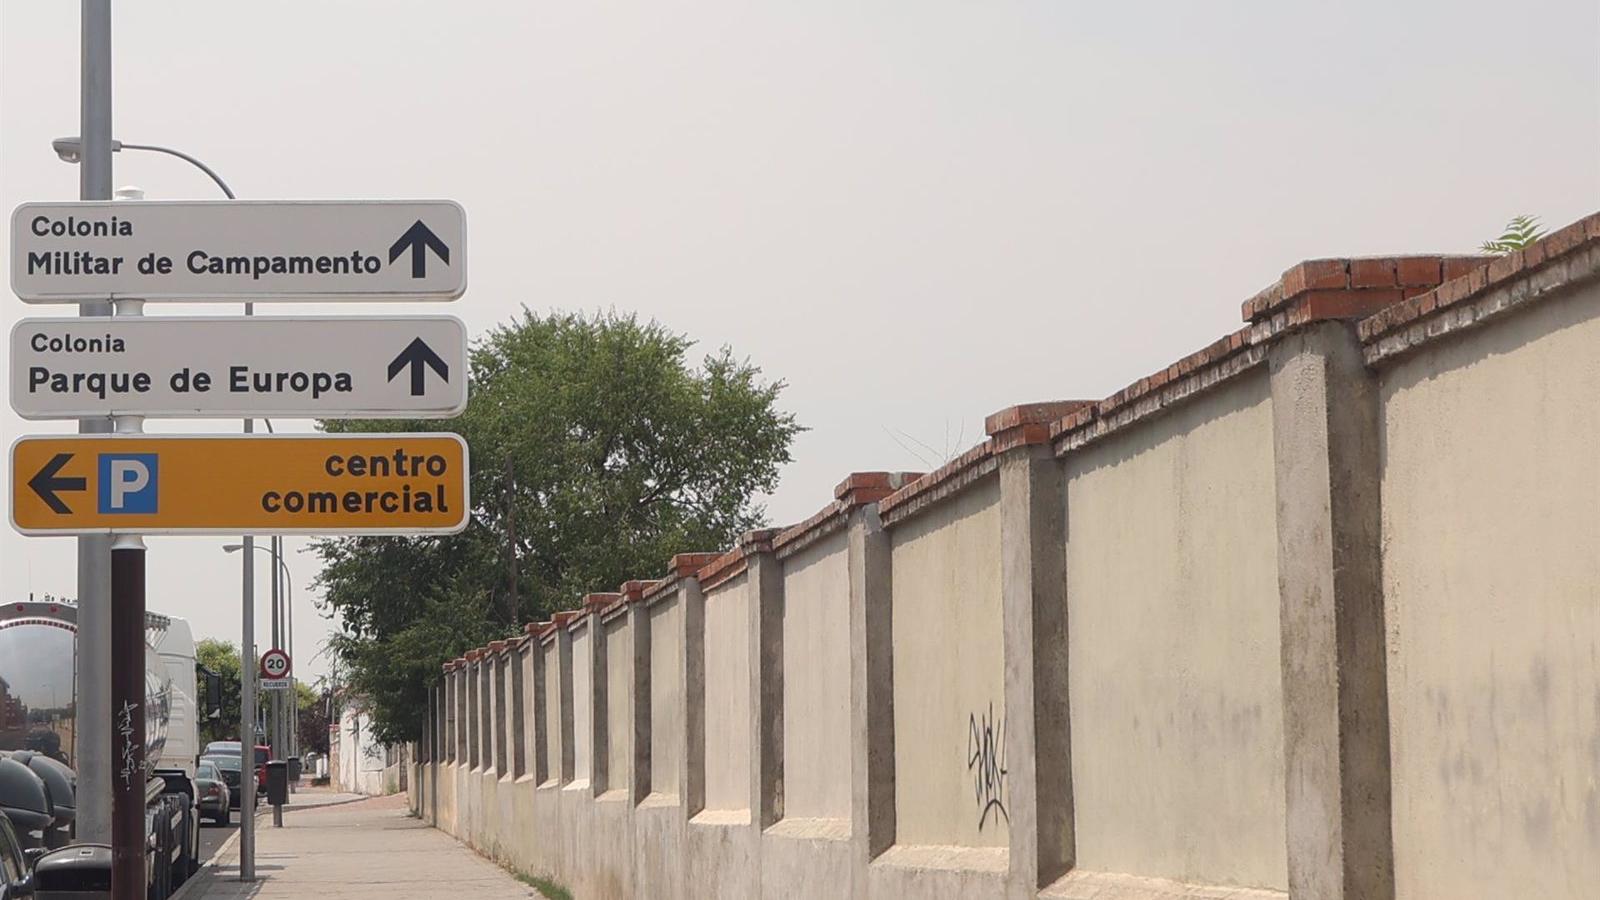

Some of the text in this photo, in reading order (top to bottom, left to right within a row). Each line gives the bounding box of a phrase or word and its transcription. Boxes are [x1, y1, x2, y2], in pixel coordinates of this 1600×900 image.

[31, 216, 133, 237] Colonia
[28, 250, 382, 280] Militar de Campamento
[31, 333, 126, 353] Colonia
[29, 366, 353, 399] Parque de Europa
[325, 448, 447, 477] centro
[110, 459, 150, 509] P
[261, 485, 448, 514] comercial
[267, 658, 285, 669] 20
